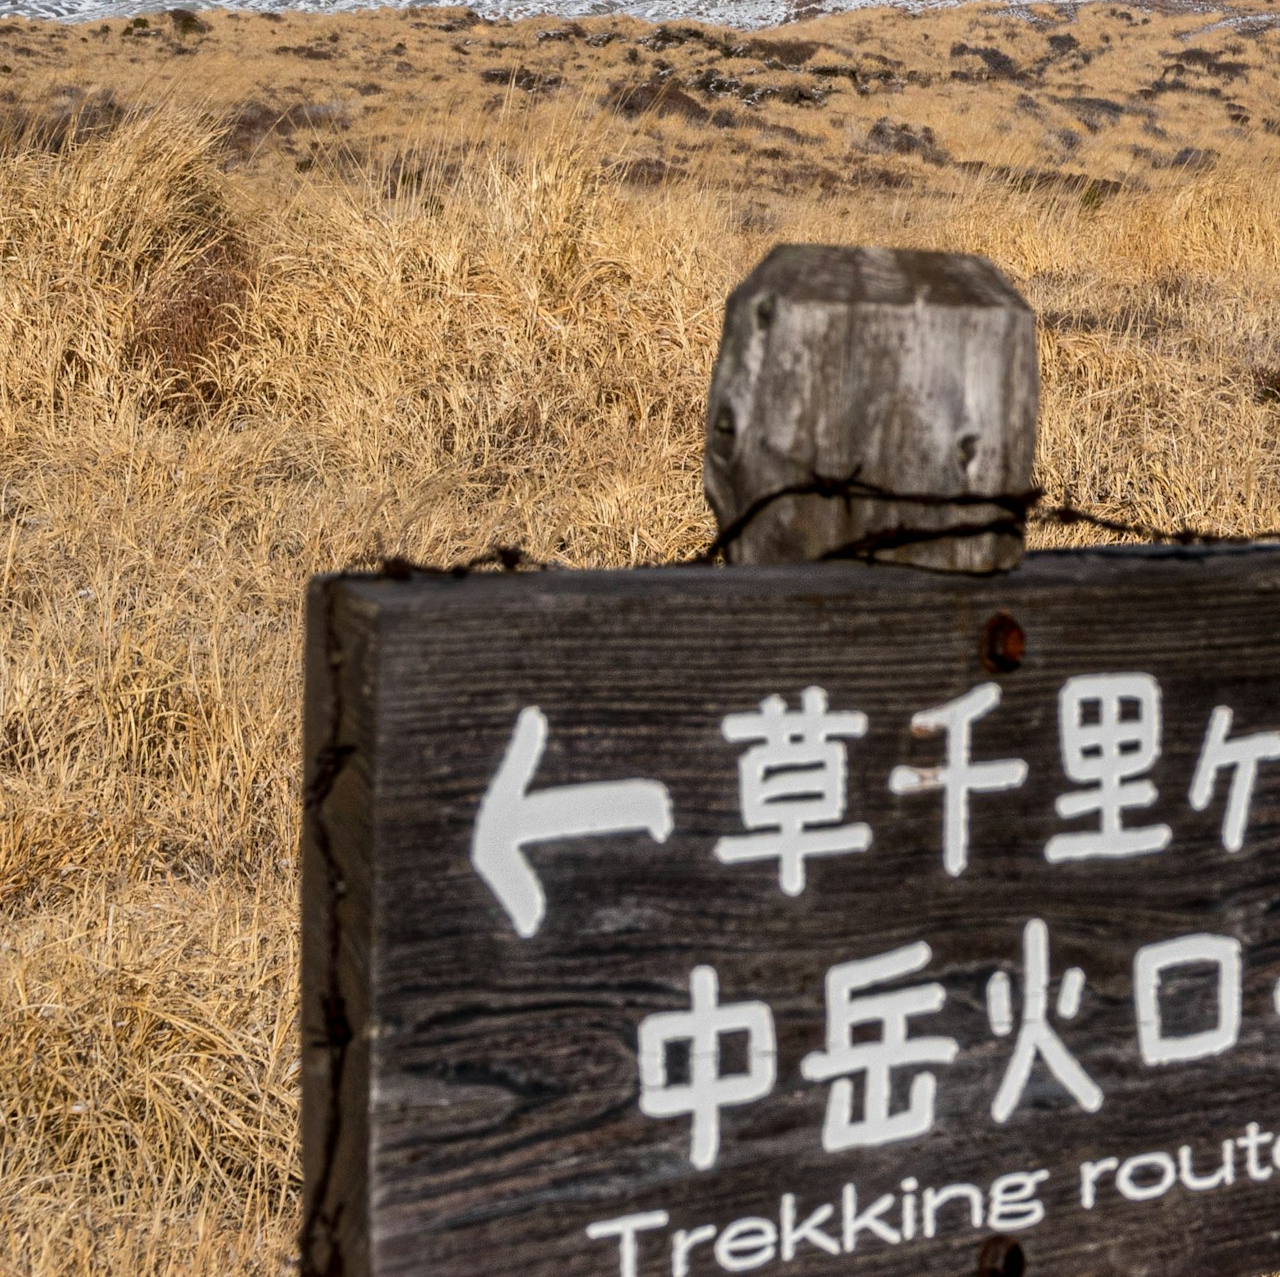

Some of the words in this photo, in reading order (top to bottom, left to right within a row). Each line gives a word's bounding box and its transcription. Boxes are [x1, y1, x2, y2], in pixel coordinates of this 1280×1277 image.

[637, 918, 1242, 1171] 中岳火口
[585, 1169, 1050, 1277] Trekking
